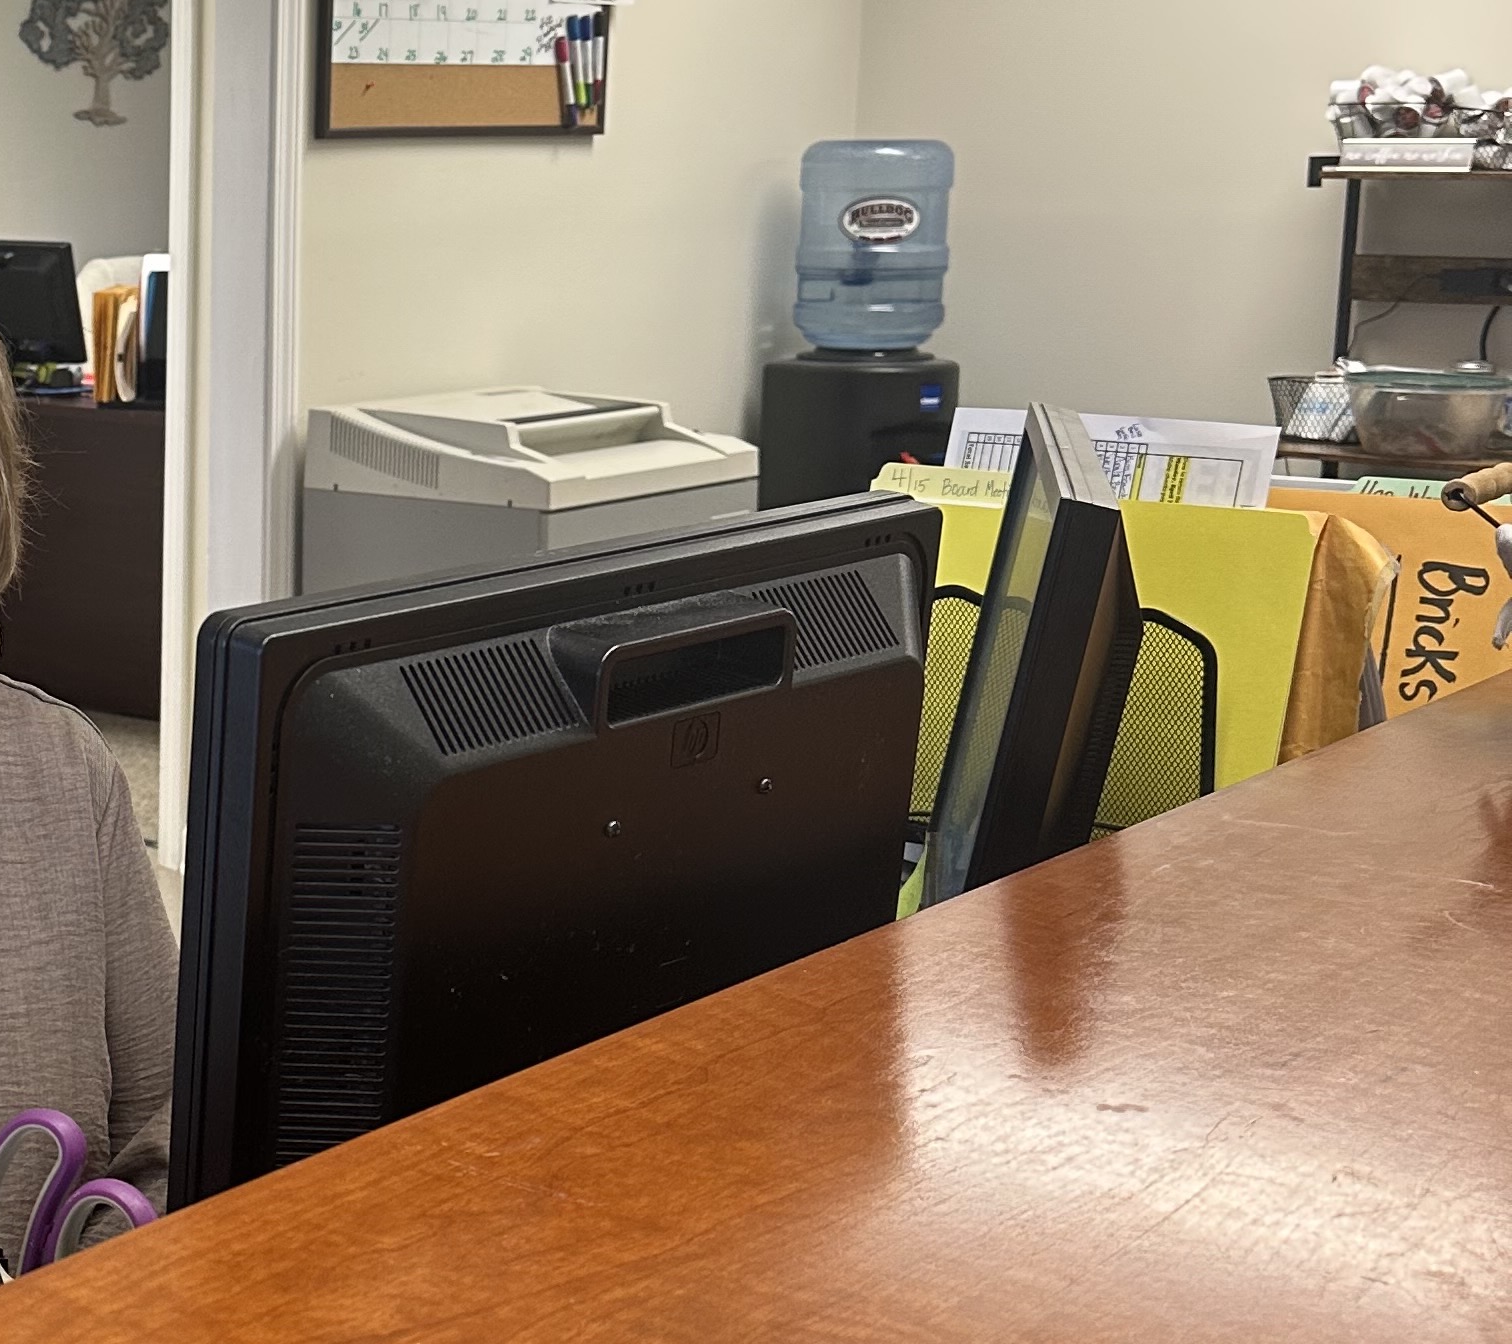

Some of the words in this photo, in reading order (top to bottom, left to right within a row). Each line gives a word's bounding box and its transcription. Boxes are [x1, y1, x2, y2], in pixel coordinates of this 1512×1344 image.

[437, 5, 447, 21] 19
[466, 8, 478, 21] 20
[497, 8, 507, 21] 21
[525, 9, 536, 21] 22
[348, 46, 359, 60] 23
[892, 467, 931, 493] 4/15
[942, 478, 980, 498] Board
[1399, 561, 1490, 702] Bricks
